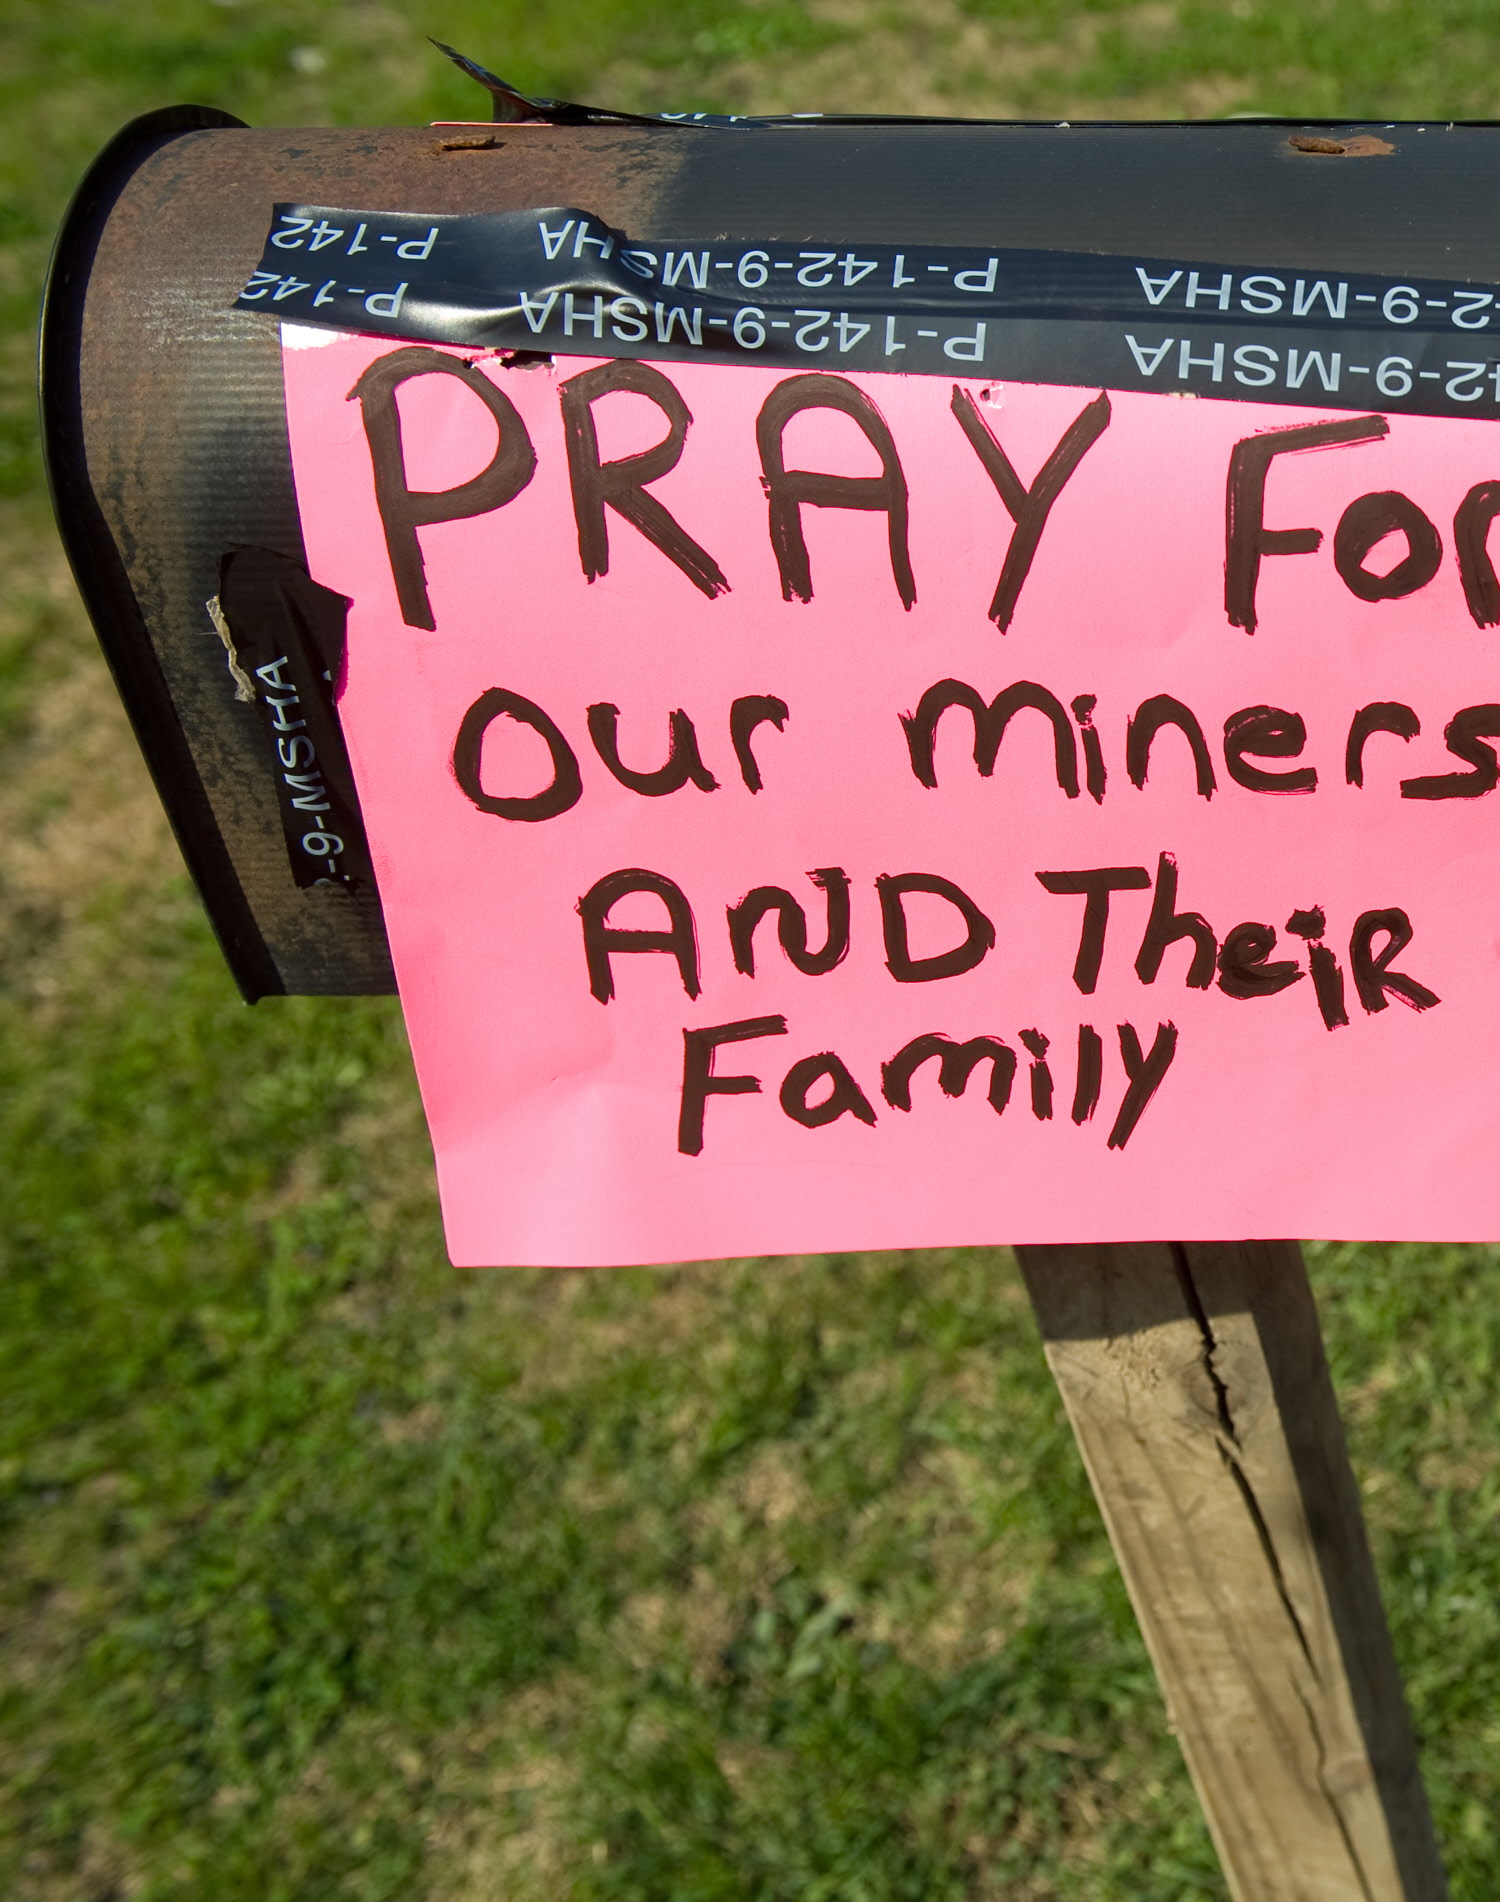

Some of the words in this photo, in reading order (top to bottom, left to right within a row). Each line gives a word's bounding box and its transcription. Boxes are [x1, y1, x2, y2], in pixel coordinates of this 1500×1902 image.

[538, 219, 999, 293] P-142-9-MSHA
[519, 291, 987, 362] P-142-9-MSHA
[346, 344, 1111, 635] PRAY
[576, 867, 997, 1005] AND
[678, 1014, 1178, 1156] Family
